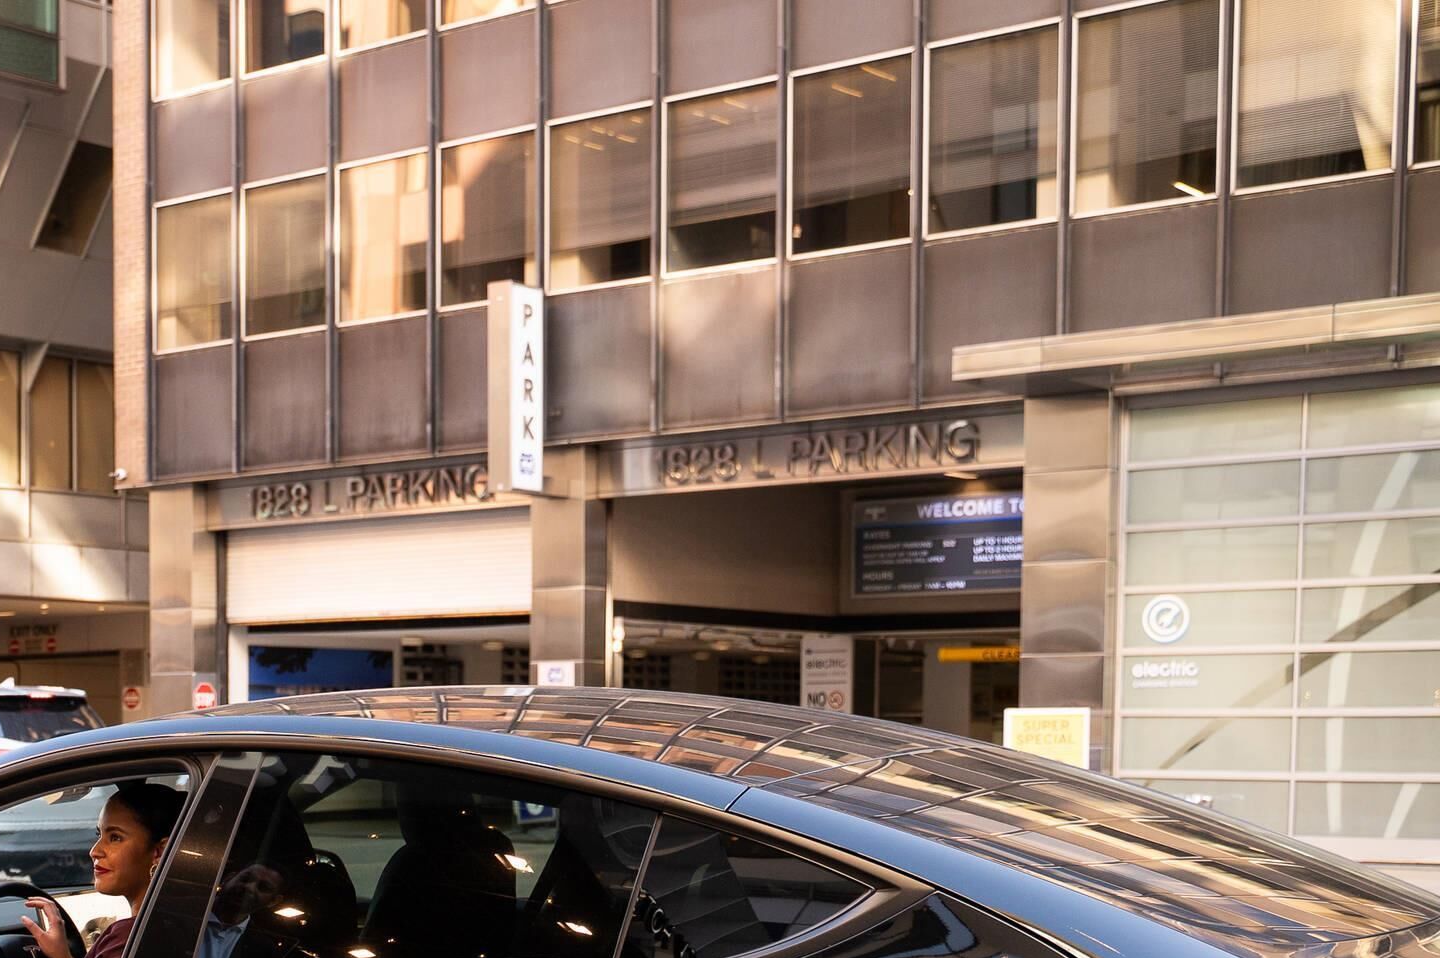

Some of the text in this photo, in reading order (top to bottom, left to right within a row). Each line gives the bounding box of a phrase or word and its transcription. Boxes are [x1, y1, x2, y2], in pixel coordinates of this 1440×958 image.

[522, 303, 535, 441] PARK
[785, 419, 981, 477] PARKING
[345, 464, 490, 512] PARKING
[917, 498, 1004, 519] WELCOME
[807, 691, 827, 706] NO
[1023, 719, 1070, 732] SUPER
[1015, 733, 1074, 745] SPECIAL
